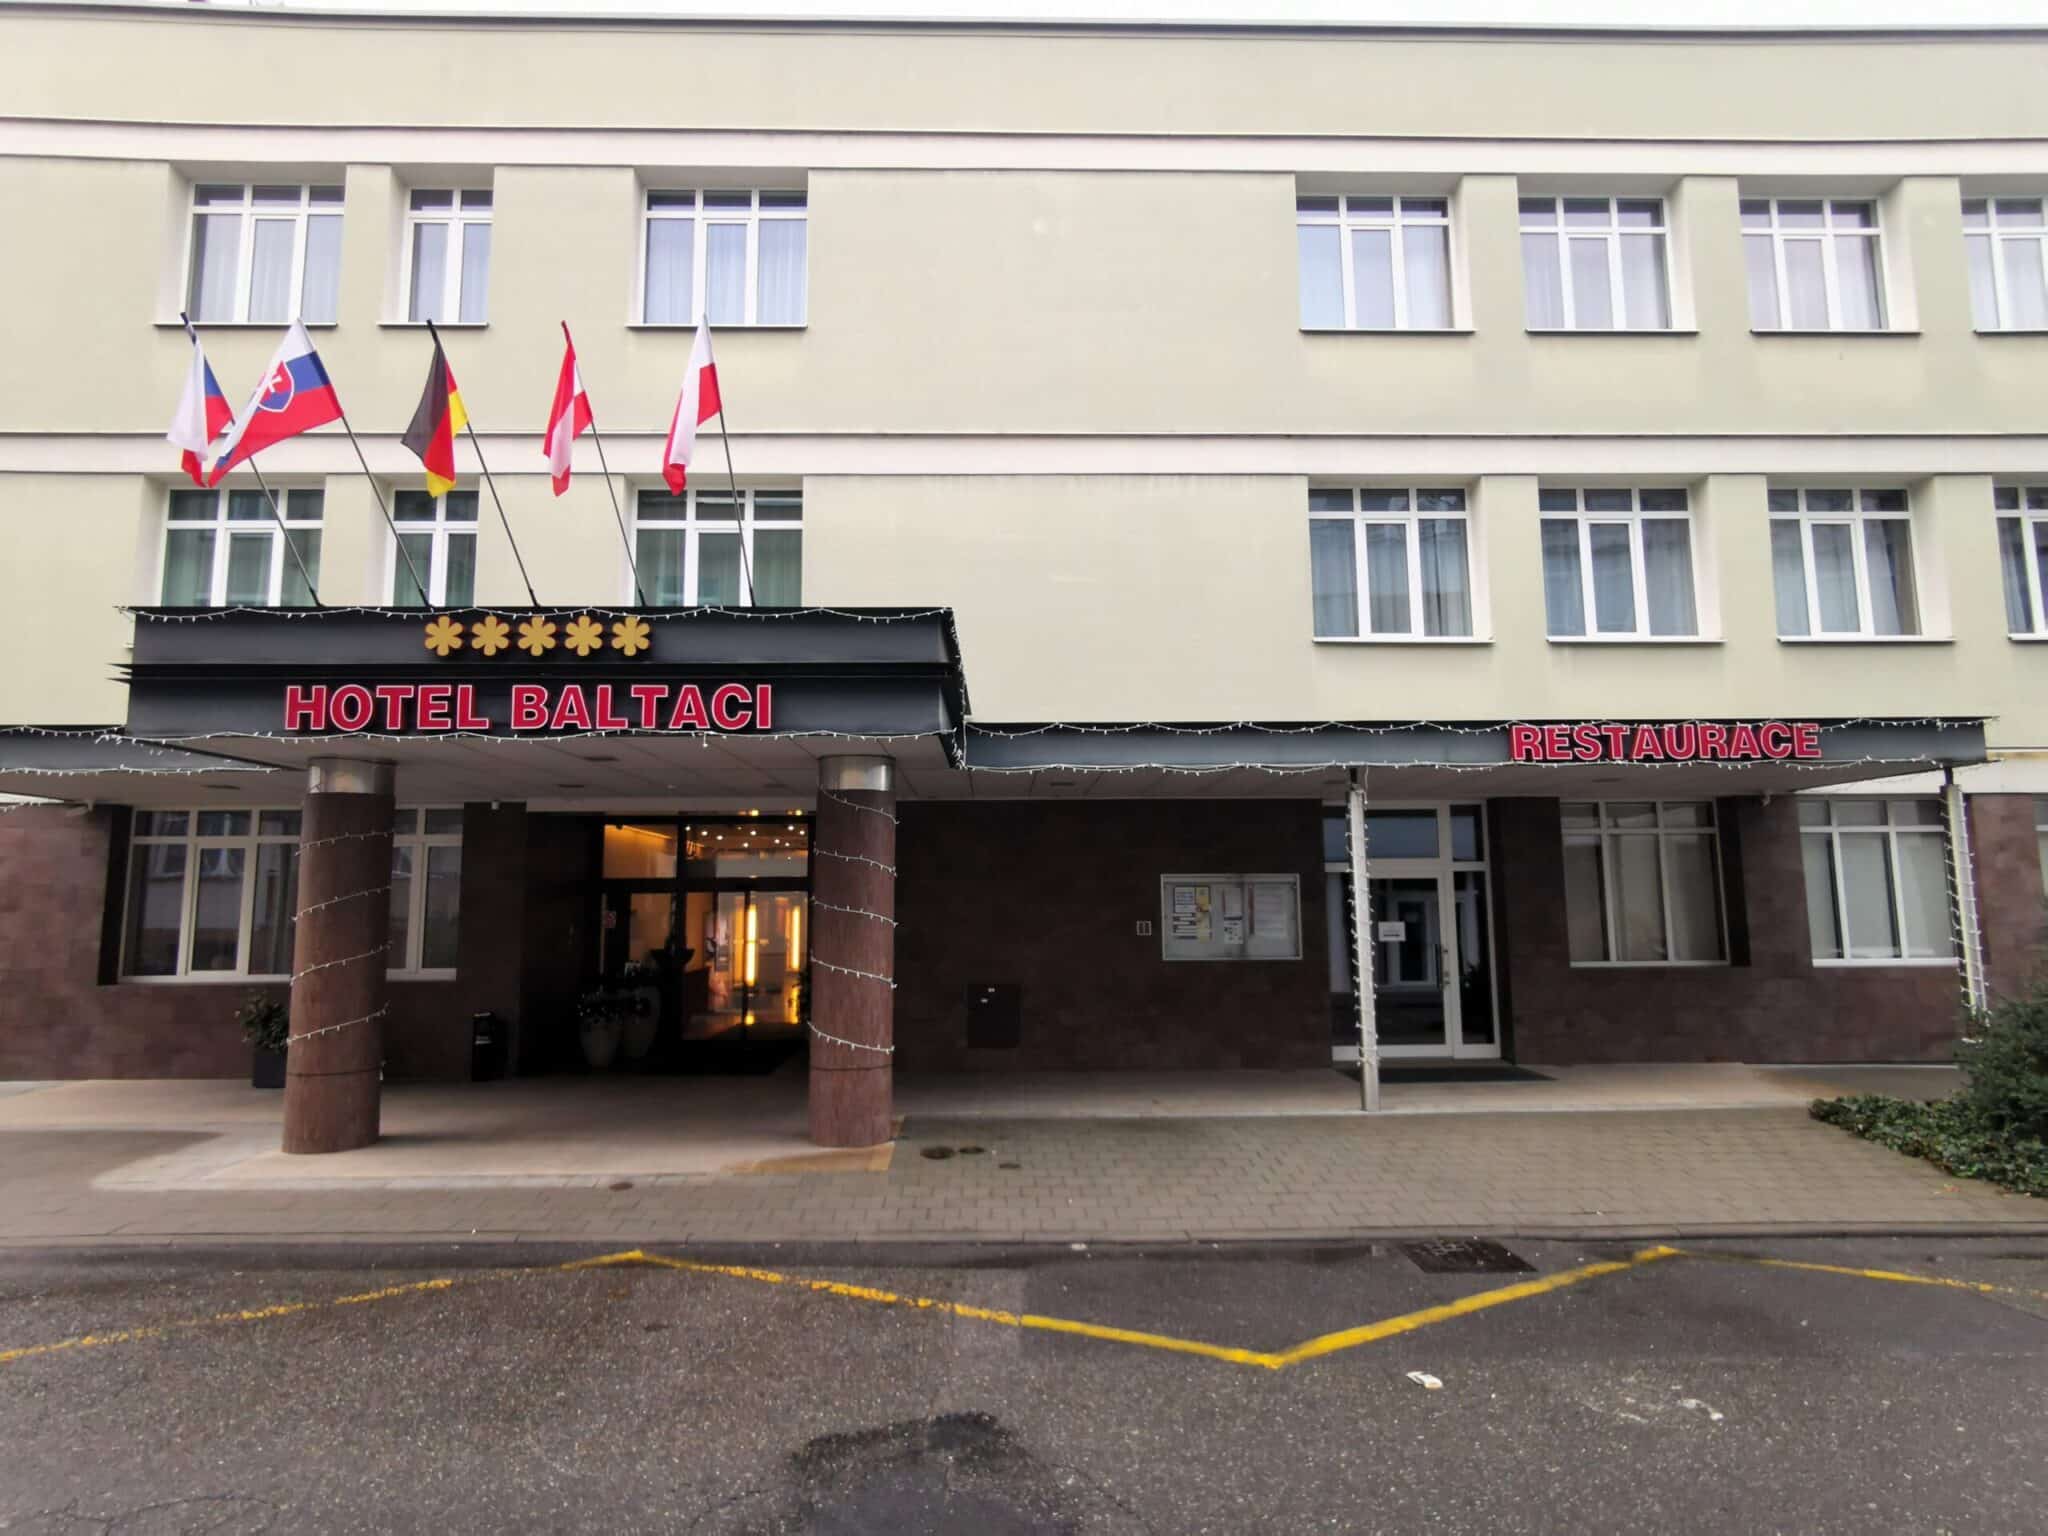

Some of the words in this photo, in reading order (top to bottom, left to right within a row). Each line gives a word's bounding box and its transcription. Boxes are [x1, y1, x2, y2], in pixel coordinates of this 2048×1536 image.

[284, 685, 490, 730] HOTEL
[511, 684, 773, 730] BALTACI
[1511, 723, 1823, 761] RESTAURACE
